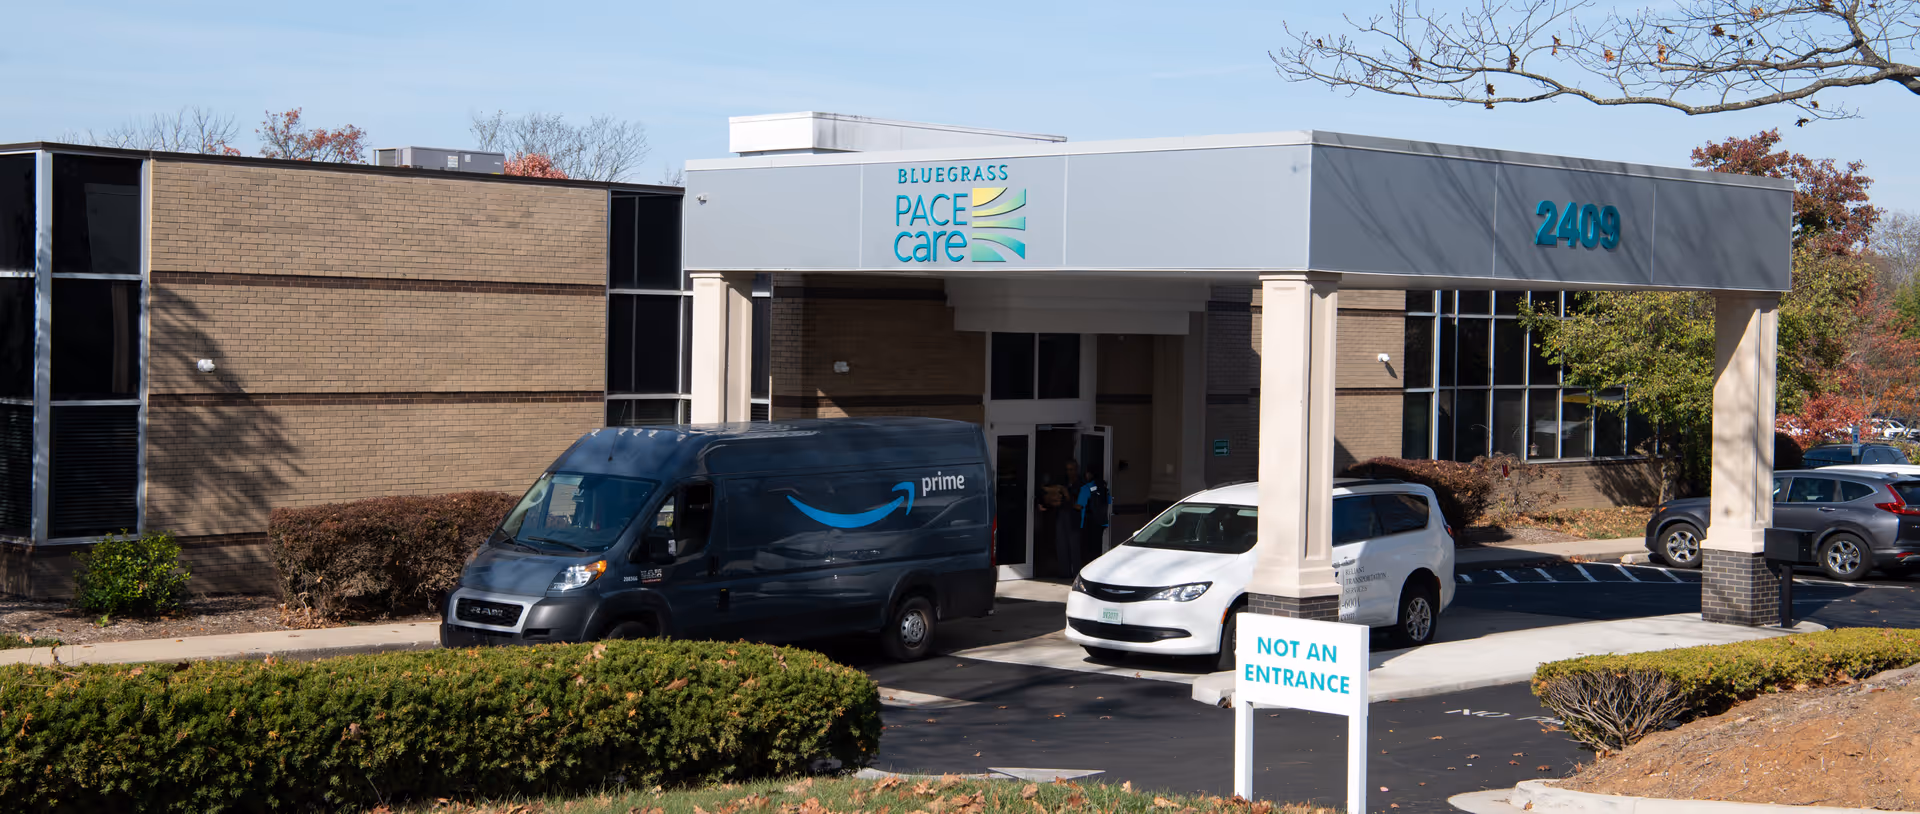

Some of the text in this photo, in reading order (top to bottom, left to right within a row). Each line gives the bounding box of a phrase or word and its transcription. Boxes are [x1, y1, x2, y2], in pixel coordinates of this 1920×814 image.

[898, 164, 1008, 184] BLUEGRASS
[896, 193, 968, 226] PACE
[1535, 200, 1621, 250] 2409
[894, 230, 967, 262] care
[922, 471, 965, 496] prime
[1345, 566, 1365, 575] RELIANT
[1345, 572, 1387, 585] TRANSPORTATION
[1345, 586, 1368, 594] SERVICES
[1257, 636, 1337, 663] NOT AN
[1245, 664, 1350, 694] ENTRANCE
